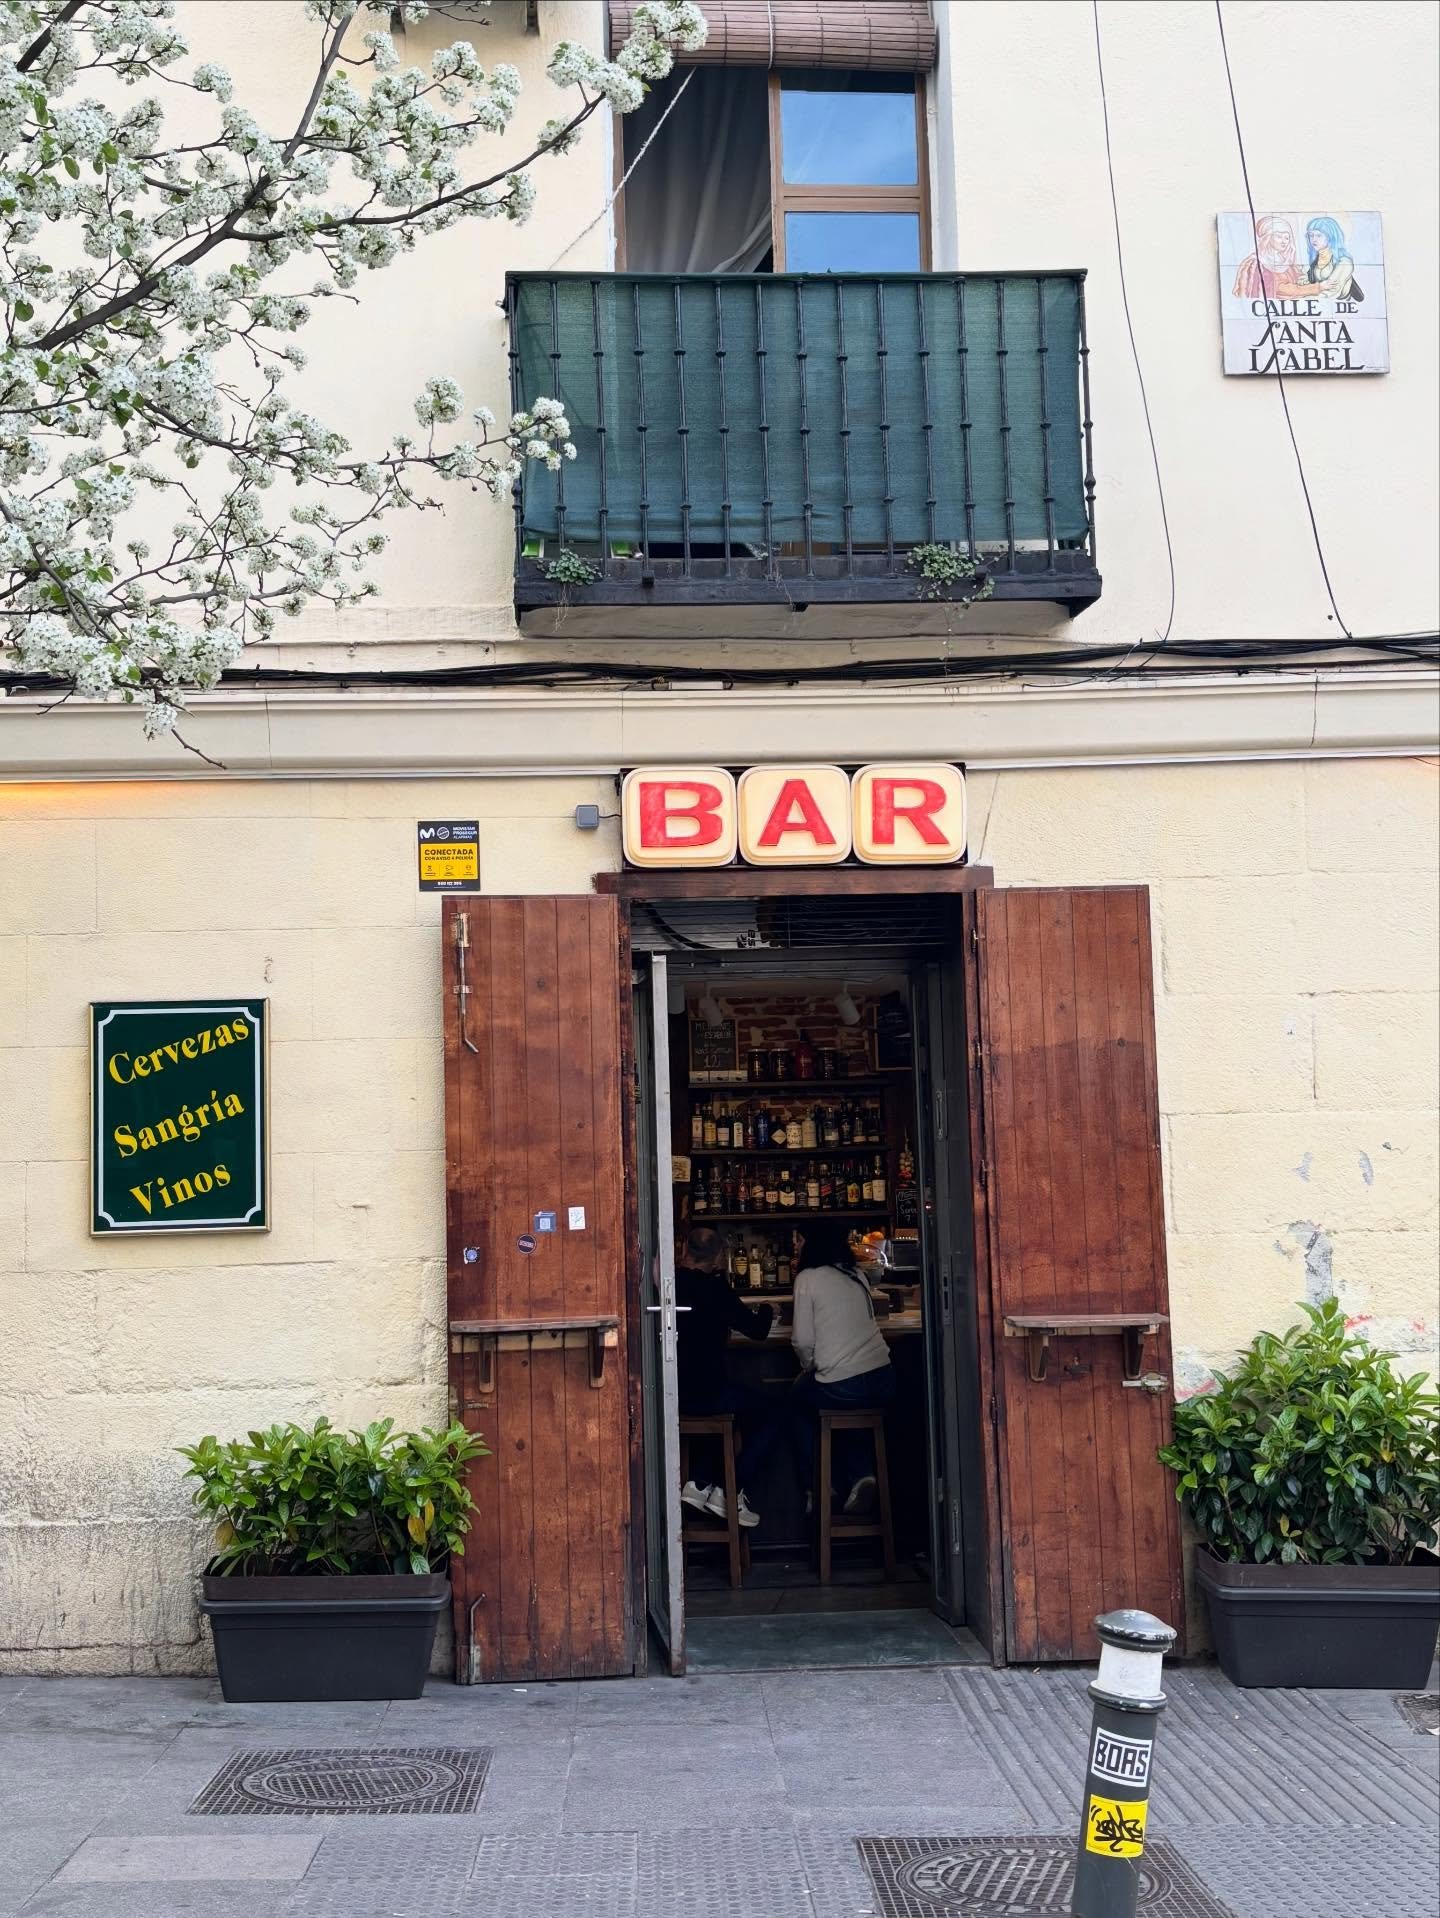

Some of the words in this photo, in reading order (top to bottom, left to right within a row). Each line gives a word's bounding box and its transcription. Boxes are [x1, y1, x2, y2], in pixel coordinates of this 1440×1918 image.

[1252, 299, 1322, 317] CALLE
[1335, 302, 1359, 314] DE
[1252, 320, 1355, 347] SANTA
[1248, 347, 1366, 374] ISABEL
[639, 777, 950, 848] BAR
[109, 1018, 249, 1084] Cervezas
[114, 1090, 245, 1158] Sangría
[129, 1164, 231, 1215] Vinos
